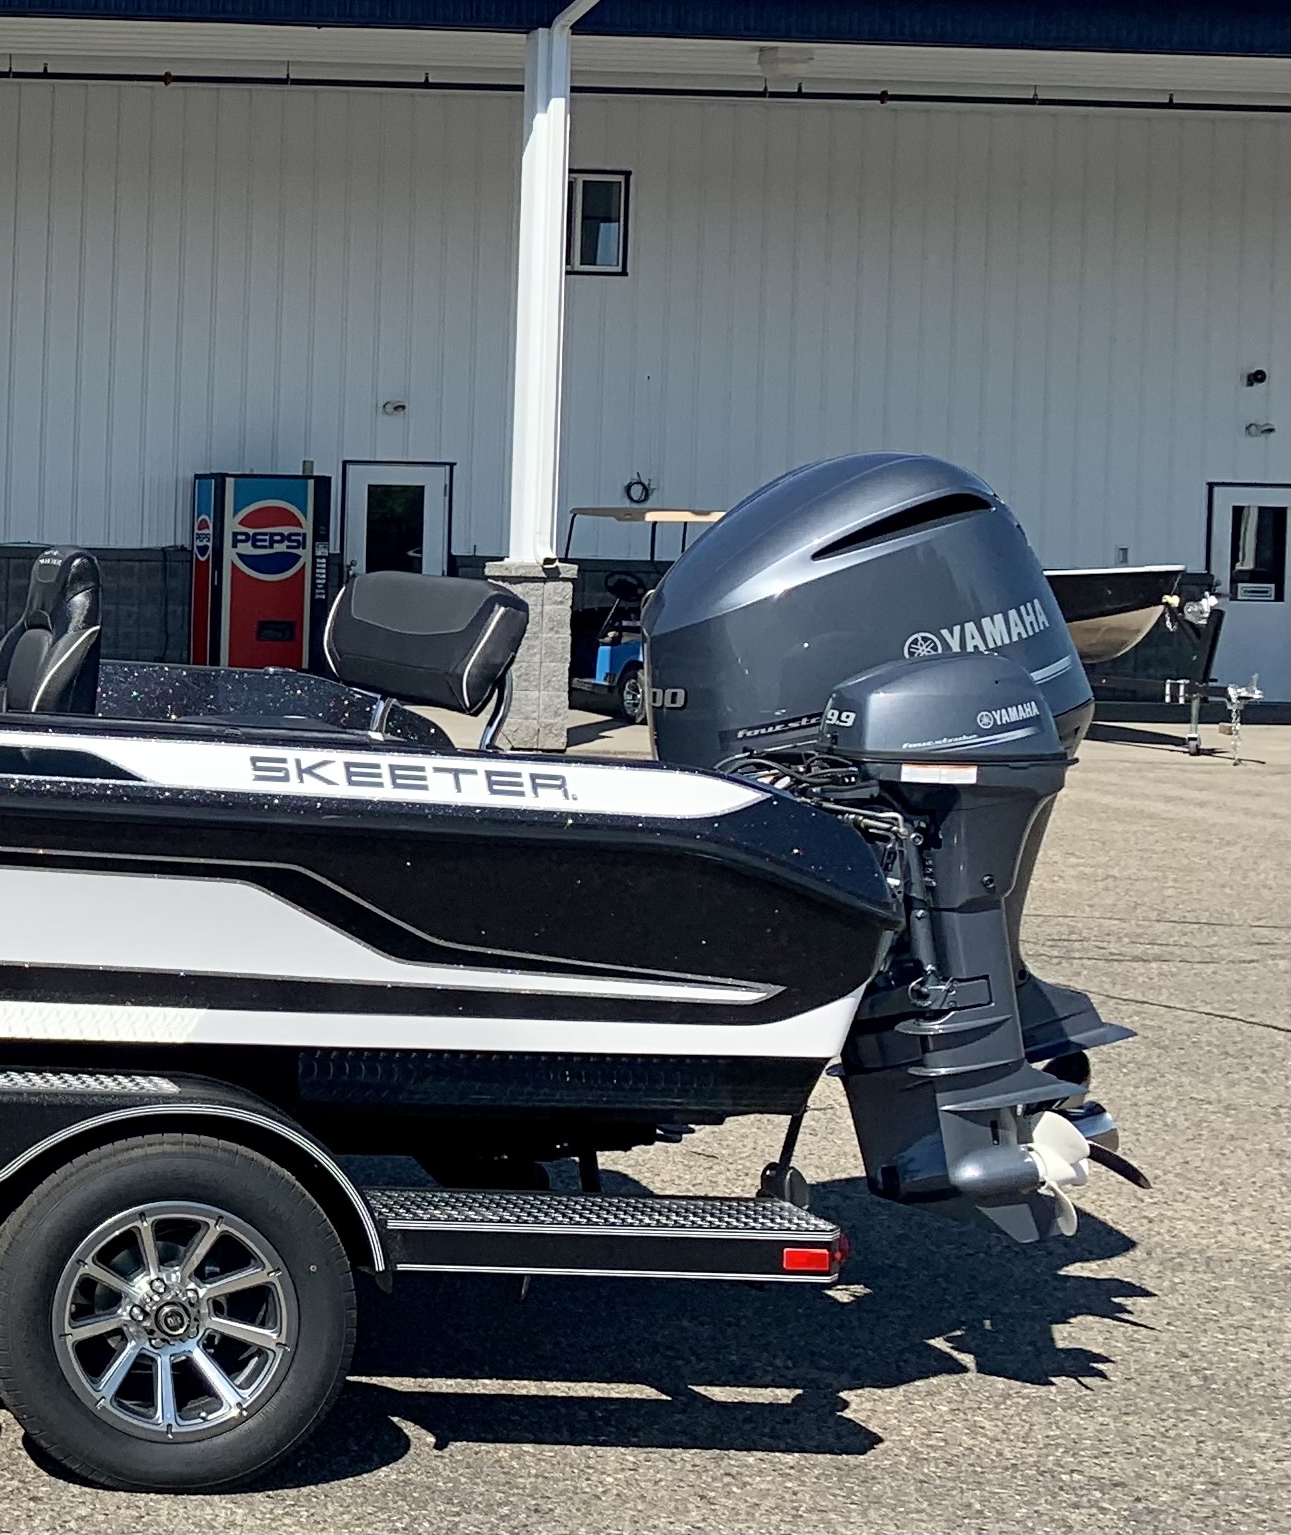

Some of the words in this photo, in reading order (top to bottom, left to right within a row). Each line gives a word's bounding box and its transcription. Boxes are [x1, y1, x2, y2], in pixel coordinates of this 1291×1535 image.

[231, 531, 307, 550] PEPSI
[939, 597, 1050, 653] YAMAHA
[825, 708, 857, 728] 9.9
[991, 700, 1040, 726] YAMAHA
[249, 755, 570, 801] SKEETER
